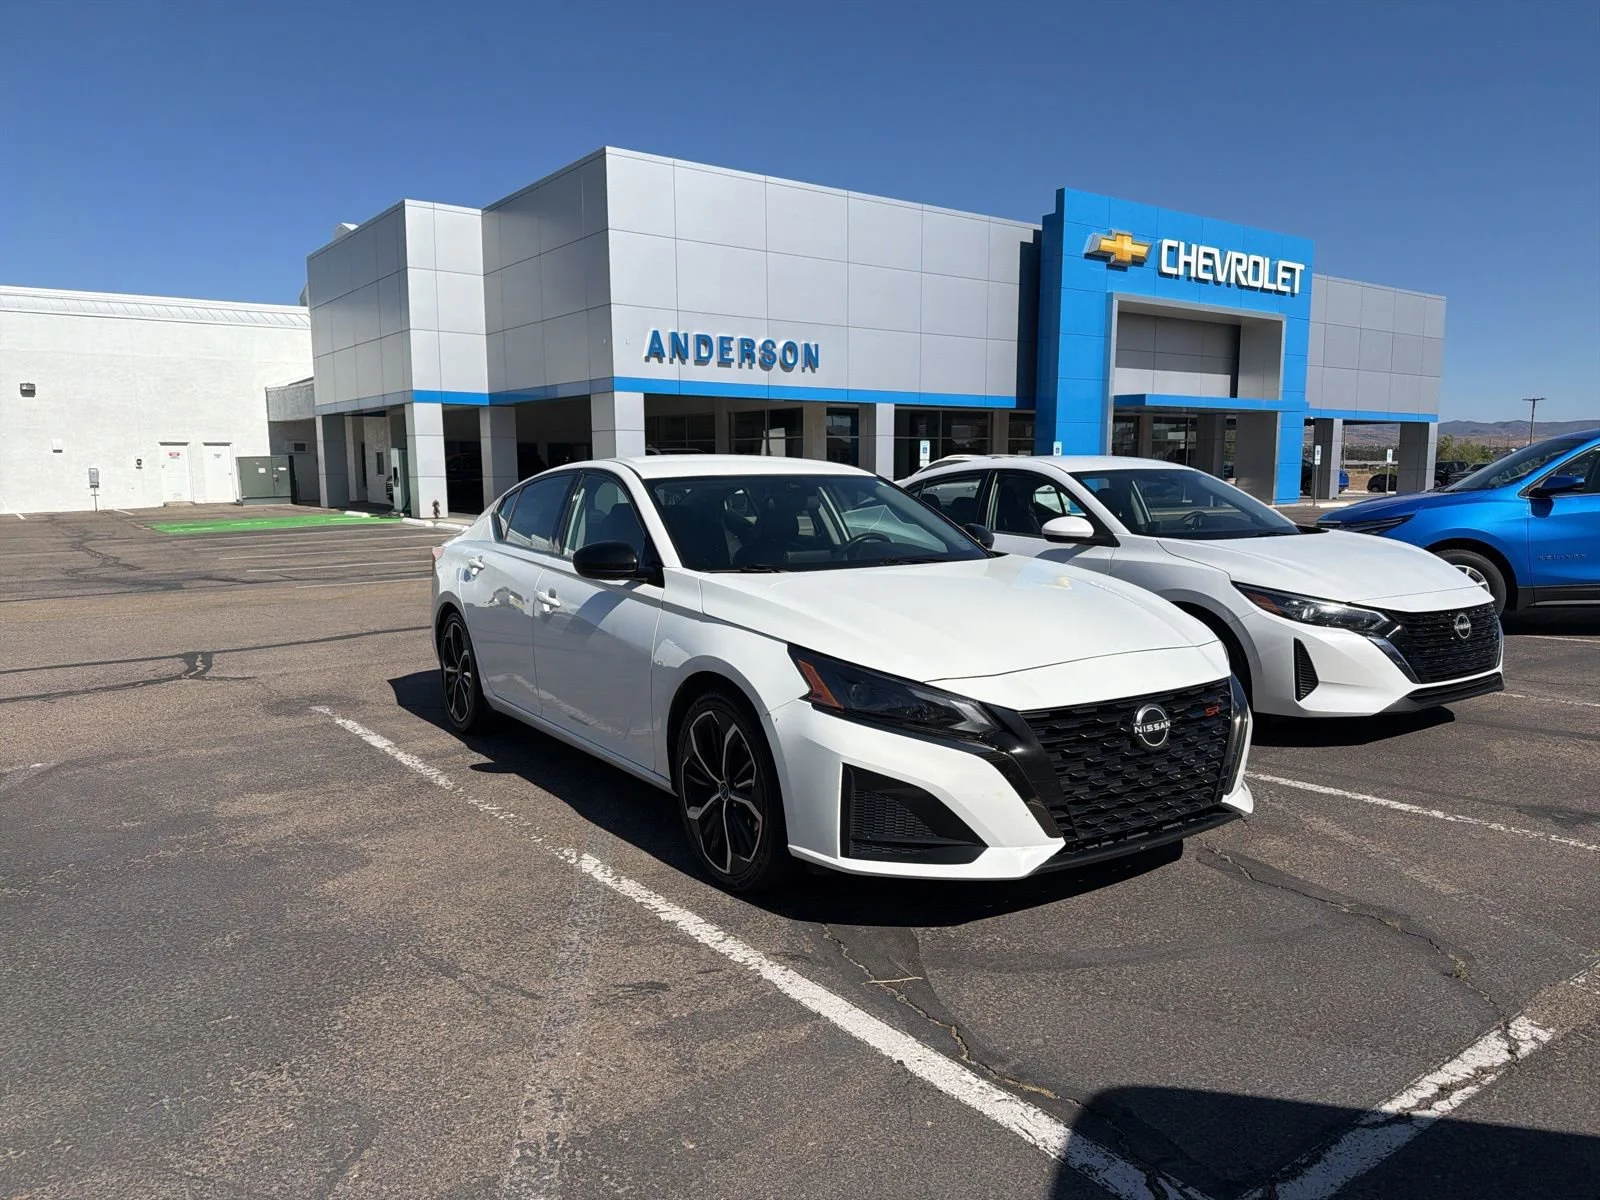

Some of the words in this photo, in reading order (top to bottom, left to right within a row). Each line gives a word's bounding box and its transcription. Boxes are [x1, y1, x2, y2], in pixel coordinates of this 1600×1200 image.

[1160, 238, 1305, 295] CHEVROLET
[645, 328, 820, 371] ANDERSON
[1205, 705, 1220, 717] SR
[1134, 720, 1171, 734] NISSAN
